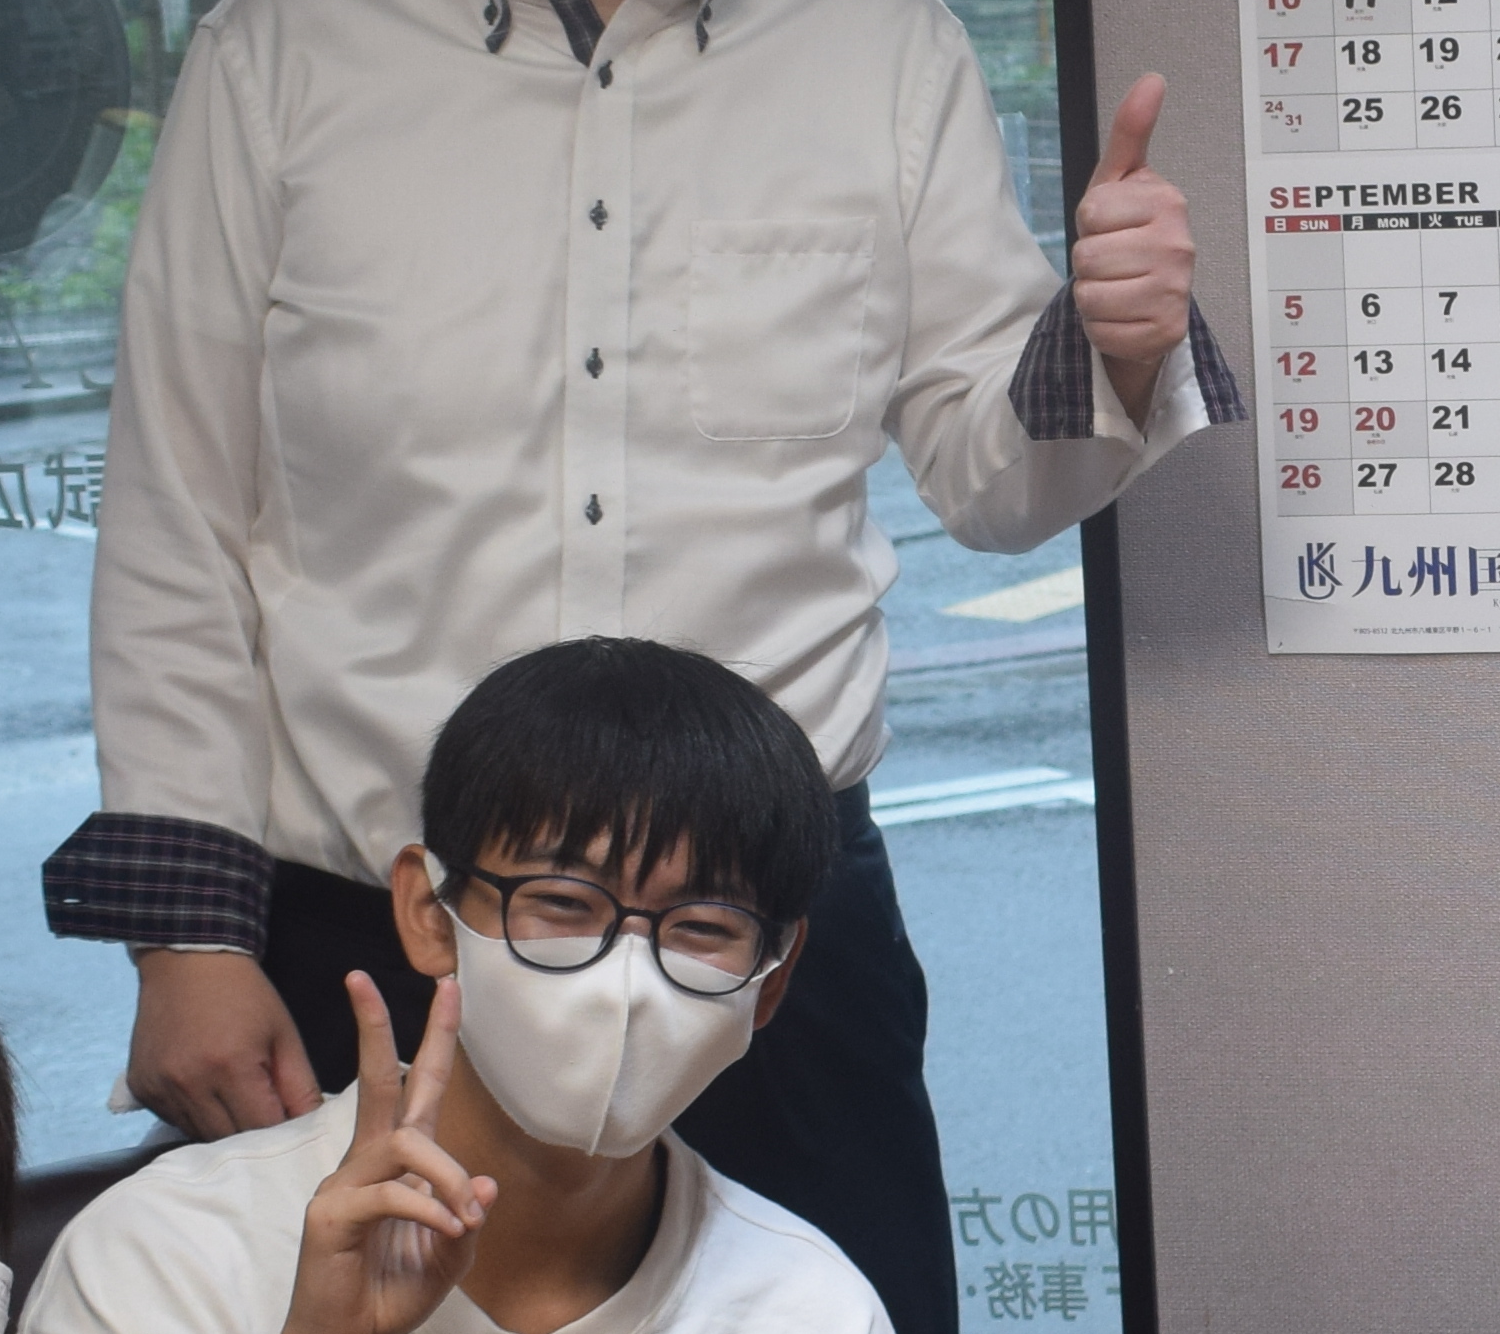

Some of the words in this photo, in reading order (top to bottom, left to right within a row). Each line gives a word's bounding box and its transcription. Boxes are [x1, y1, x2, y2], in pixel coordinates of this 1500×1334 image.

[1270, 182, 1480, 209] SEPTEMBER
[1285, 296, 1303, 319] 5
[1362, 294, 1380, 317] 6
[1439, 292, 1457, 315] 7
[1278, 352, 1316, 375] 12
[1354, 350, 1393, 374] 13
[1432, 349, 1471, 372] 14
[1281, 465, 1321, 488] 26
[1358, 464, 1397, 487] 27
[1435, 462, 1474, 485] 28
